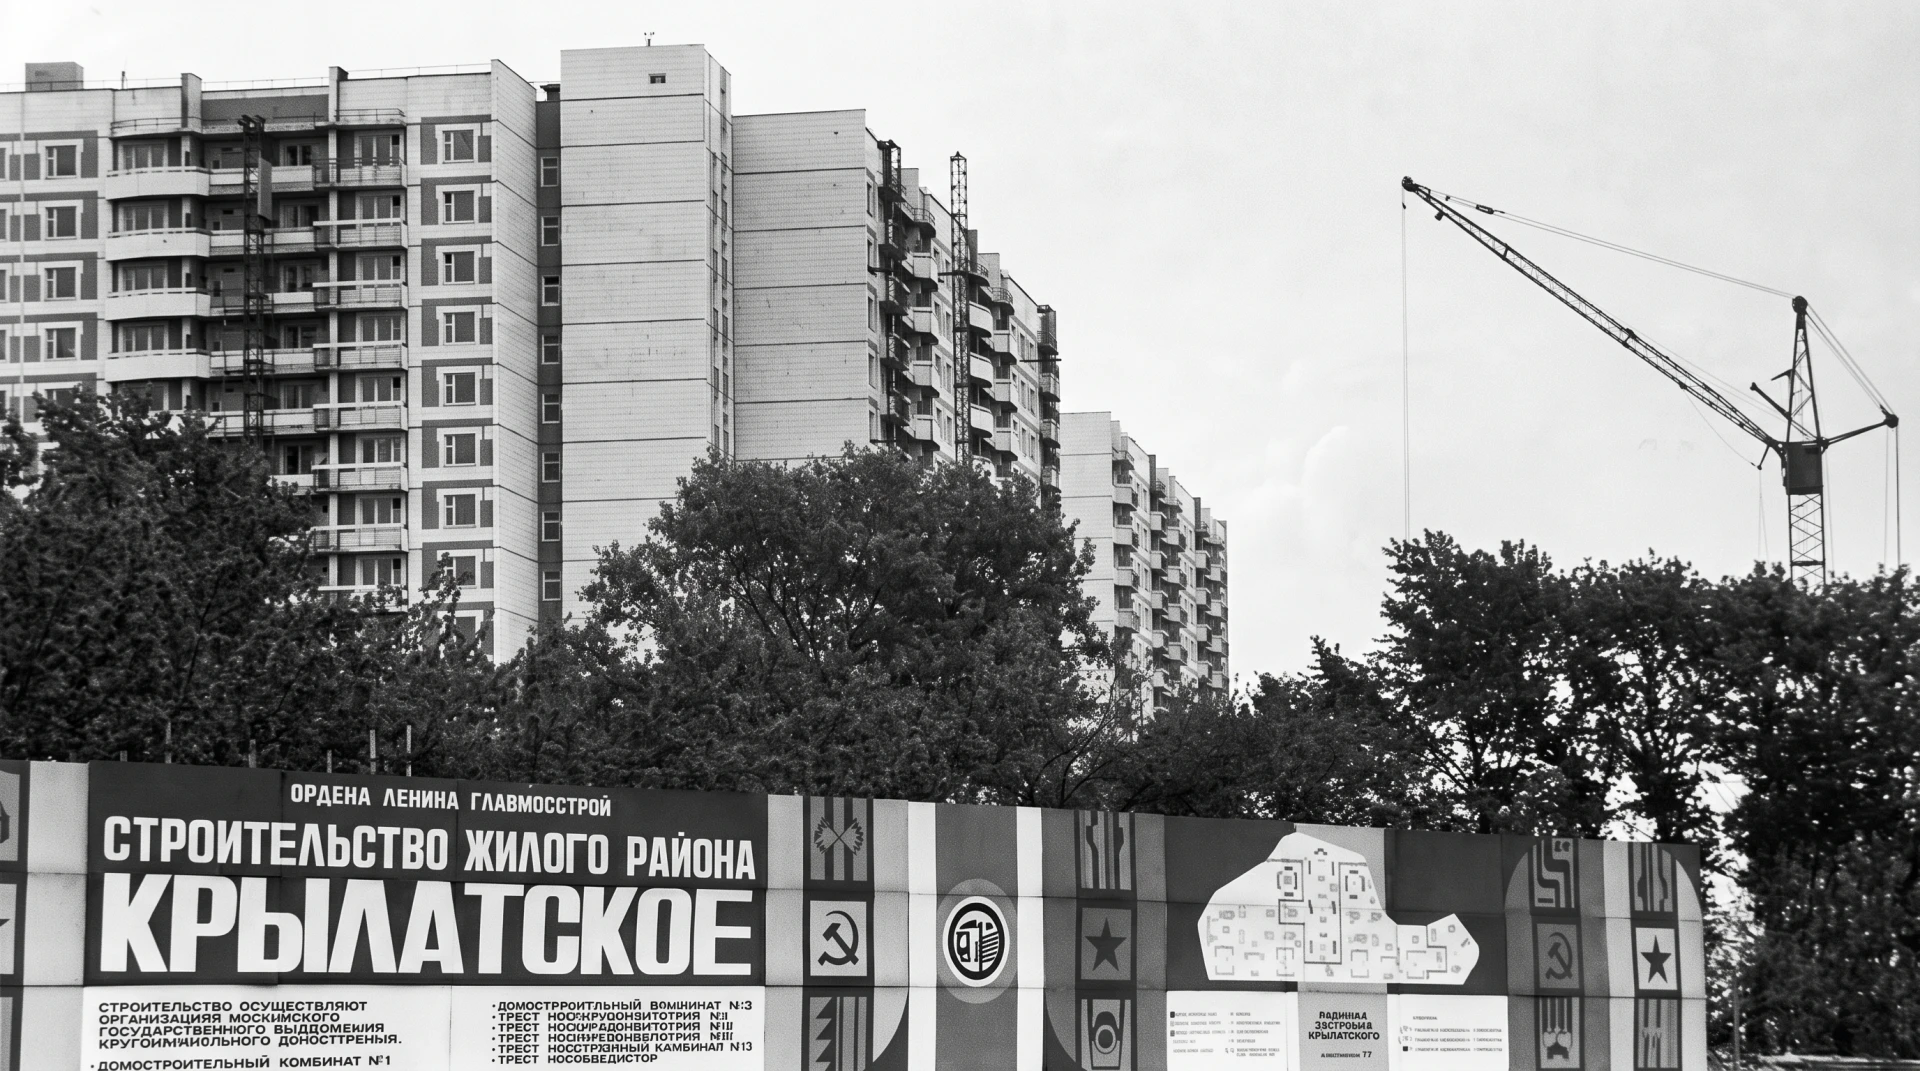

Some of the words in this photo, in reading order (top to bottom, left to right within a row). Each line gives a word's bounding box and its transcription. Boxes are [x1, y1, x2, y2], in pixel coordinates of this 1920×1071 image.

[291, 784, 371, 807] ОРДЕНА
[383, 788, 459, 810] ЛЕНИНА
[471, 792, 611, 817] ГЛАВМОССТРОЙ
[104, 816, 448, 871] СТРОИТЕЛЬСТВО
[464, 829, 609, 874] ЖИЛОГО
[627, 831, 756, 880] РАЙОНА
[100, 873, 753, 976] КРЫЛАТСКОЕ
[99, 1002, 232, 1013] СТРОИТЕЛЬСТВО
[239, 1001, 367, 1013] ОСУЩЕСТВЛЯЮТ
[498, 1012, 540, 1021] ТРЕСТ
[498, 1023, 540, 1032] ТРЕСТ
[498, 1033, 540, 1043] ТРЕСТ
[1308, 1031, 1380, 1040] КРЫЛАТСКОГО
[498, 1044, 539, 1054] ТРЕСТ
[97, 1055, 270, 1071] ДОМОСТРОИТЕЛЬНЫЙ
[280, 1056, 361, 1068] КОМБИНАТ
[498, 1055, 539, 1064] ТРЕСТ
[548, 1054, 658, 1065] НОСОБВЕДИСТОР
